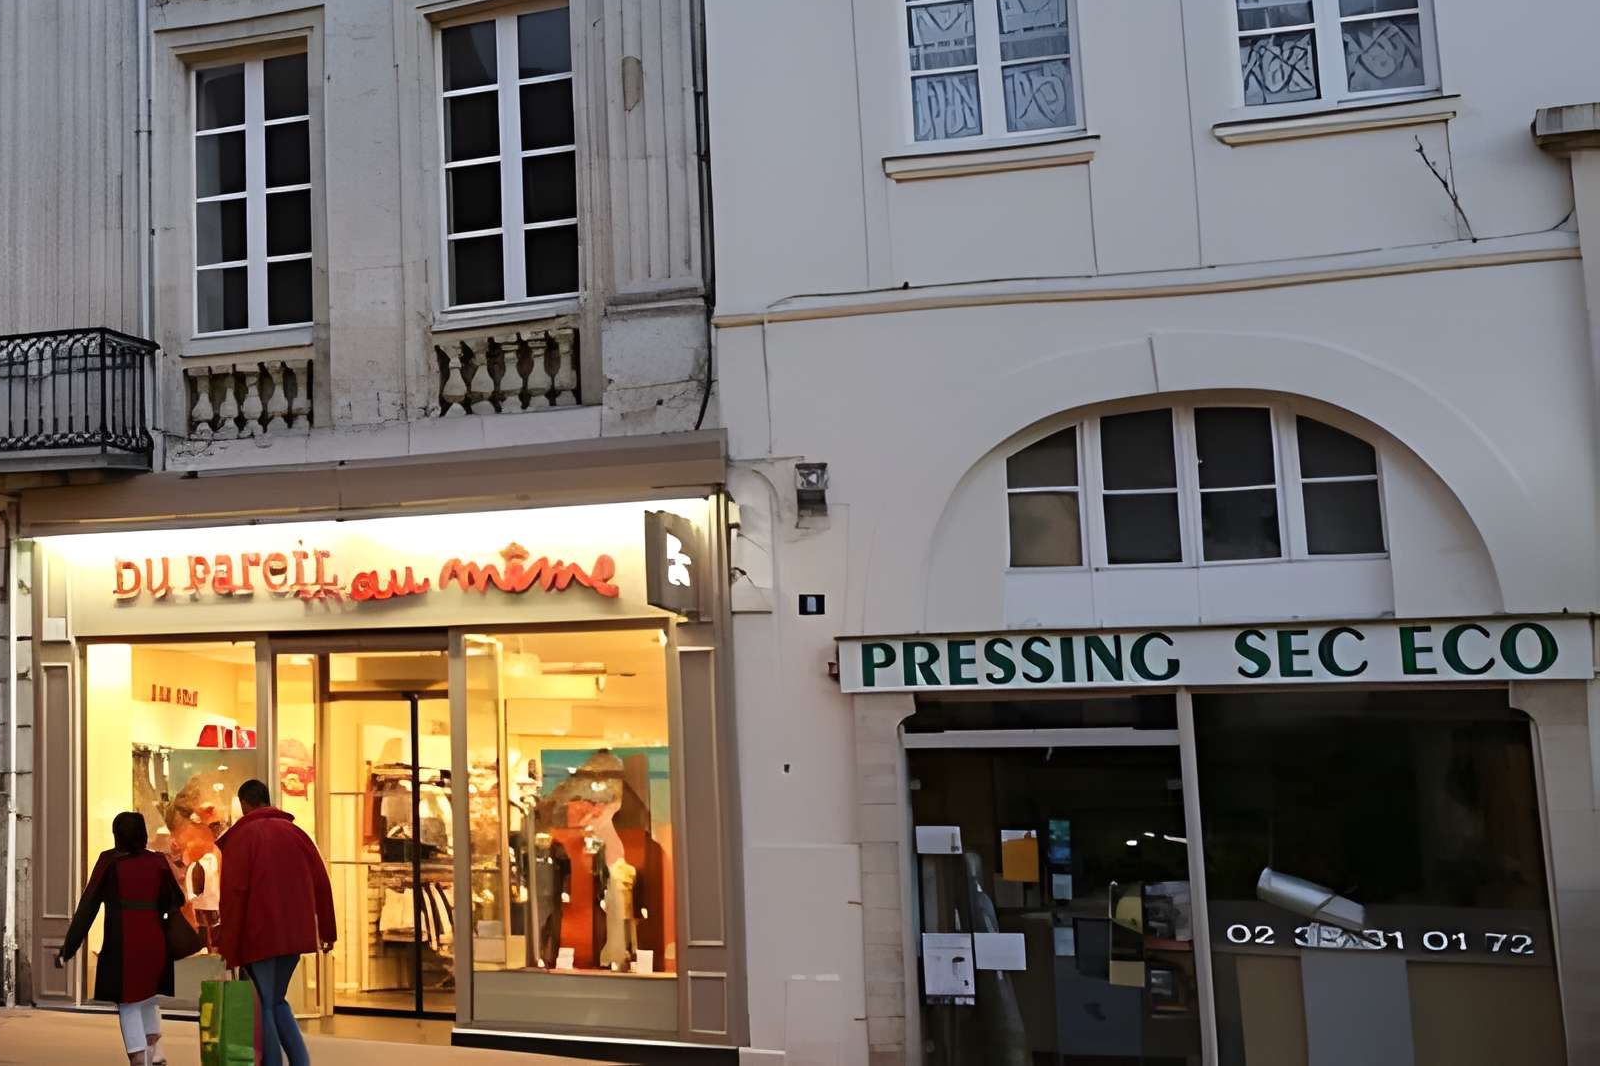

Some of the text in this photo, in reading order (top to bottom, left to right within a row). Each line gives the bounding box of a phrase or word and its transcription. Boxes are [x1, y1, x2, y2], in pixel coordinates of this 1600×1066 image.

[351, 566, 430, 601] au
[438, 542, 619, 598] même
[861, 622, 1559, 687] PRESSING SEC ECO
[1226, 924, 1276, 945] 02
[1423, 931, 1468, 951] 01
[1485, 932, 1536, 955] 72
